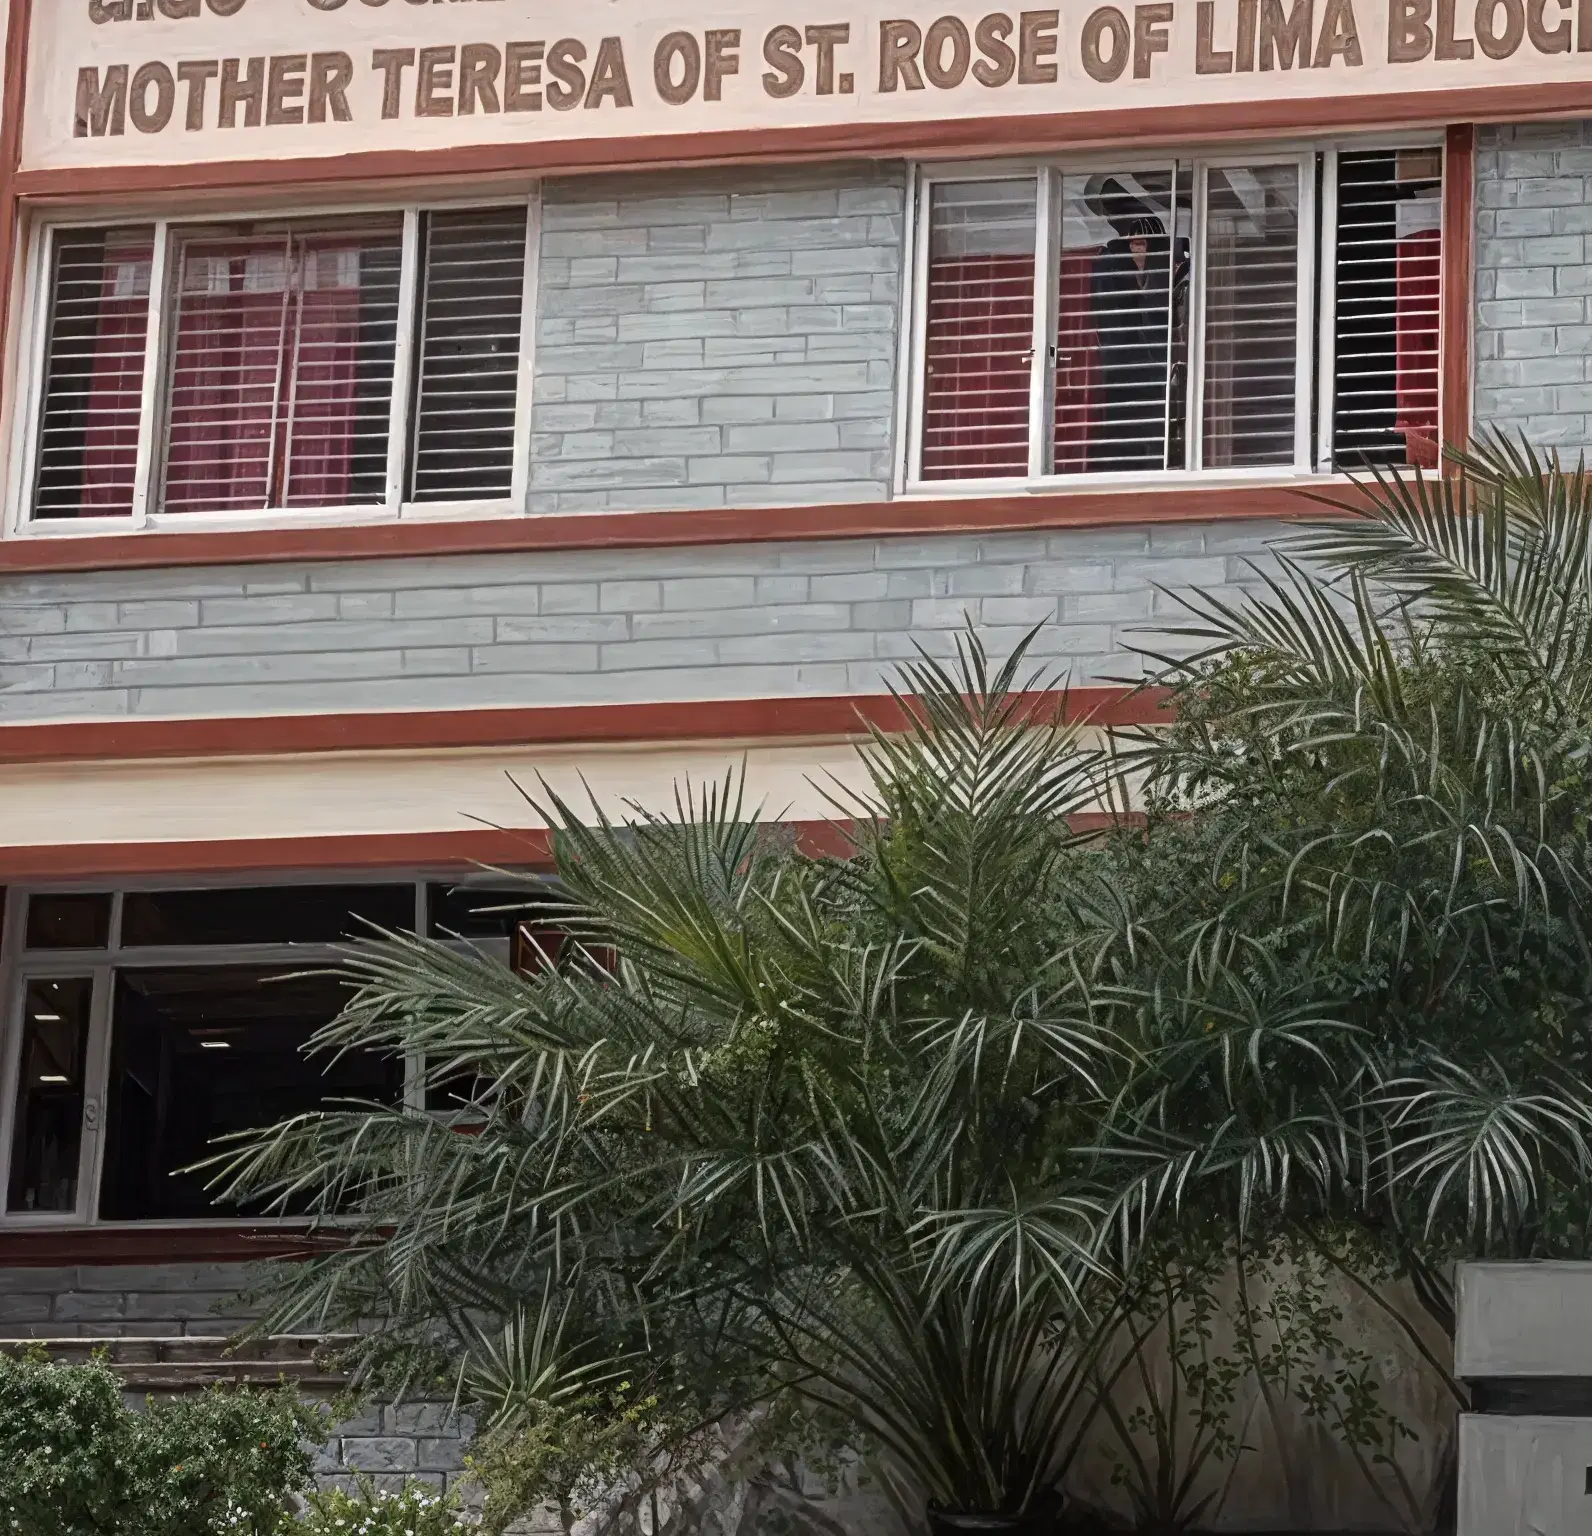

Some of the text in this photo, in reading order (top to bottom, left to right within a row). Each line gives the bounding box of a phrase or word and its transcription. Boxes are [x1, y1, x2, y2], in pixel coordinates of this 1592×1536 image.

[73, 50, 354, 138] MOTHER
[371, 36, 634, 121] TERESA
[653, 28, 742, 106] OF
[761, 22, 855, 99] ST.
[878, 9, 1060, 94] ROSE
[1080, 2, 1175, 84] OF
